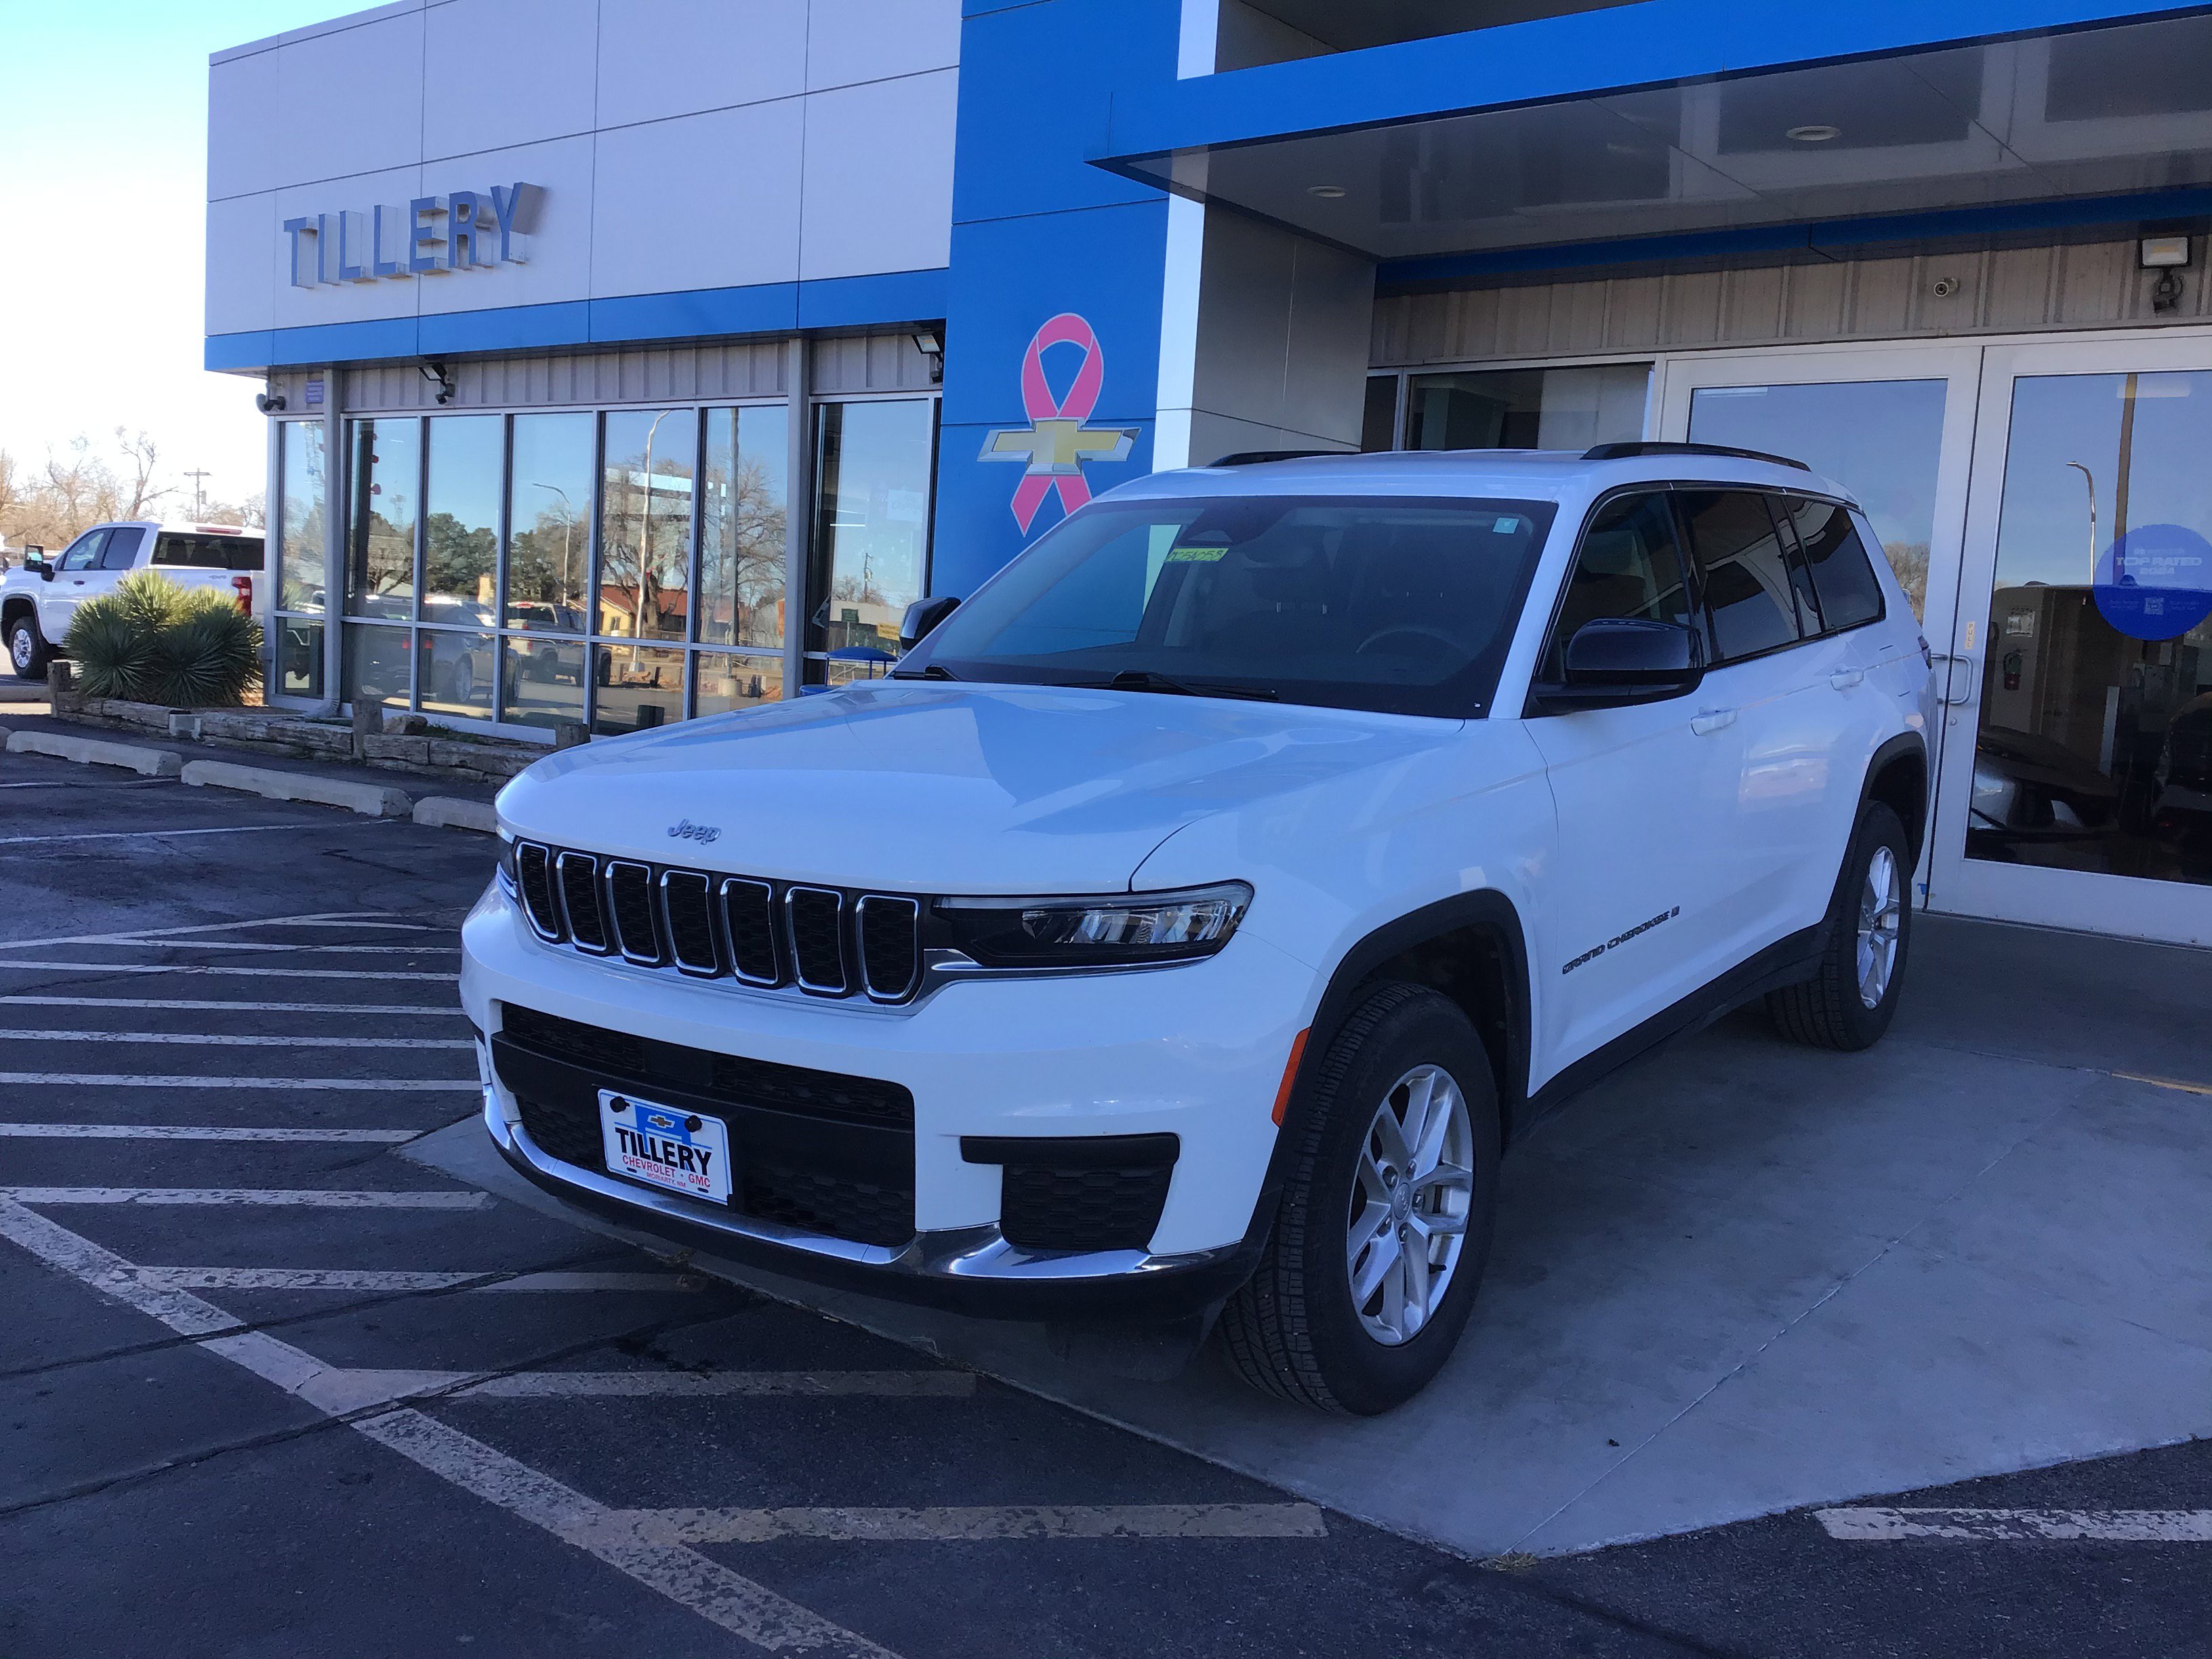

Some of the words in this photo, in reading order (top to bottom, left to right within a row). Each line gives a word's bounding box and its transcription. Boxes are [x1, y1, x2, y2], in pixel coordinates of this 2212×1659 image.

[283, 182, 530, 289] TILLERY
[2152, 556, 2203, 566] RATED
[667, 819, 721, 846] Jeep
[1562, 944, 1605, 975] GRAND
[1607, 911, 1670, 949] CHEROKEE
[615, 1127, 712, 1176] TILLERY
[622, 1155, 676, 1178] CHEVROLET
[688, 1173, 711, 1187] GMC
